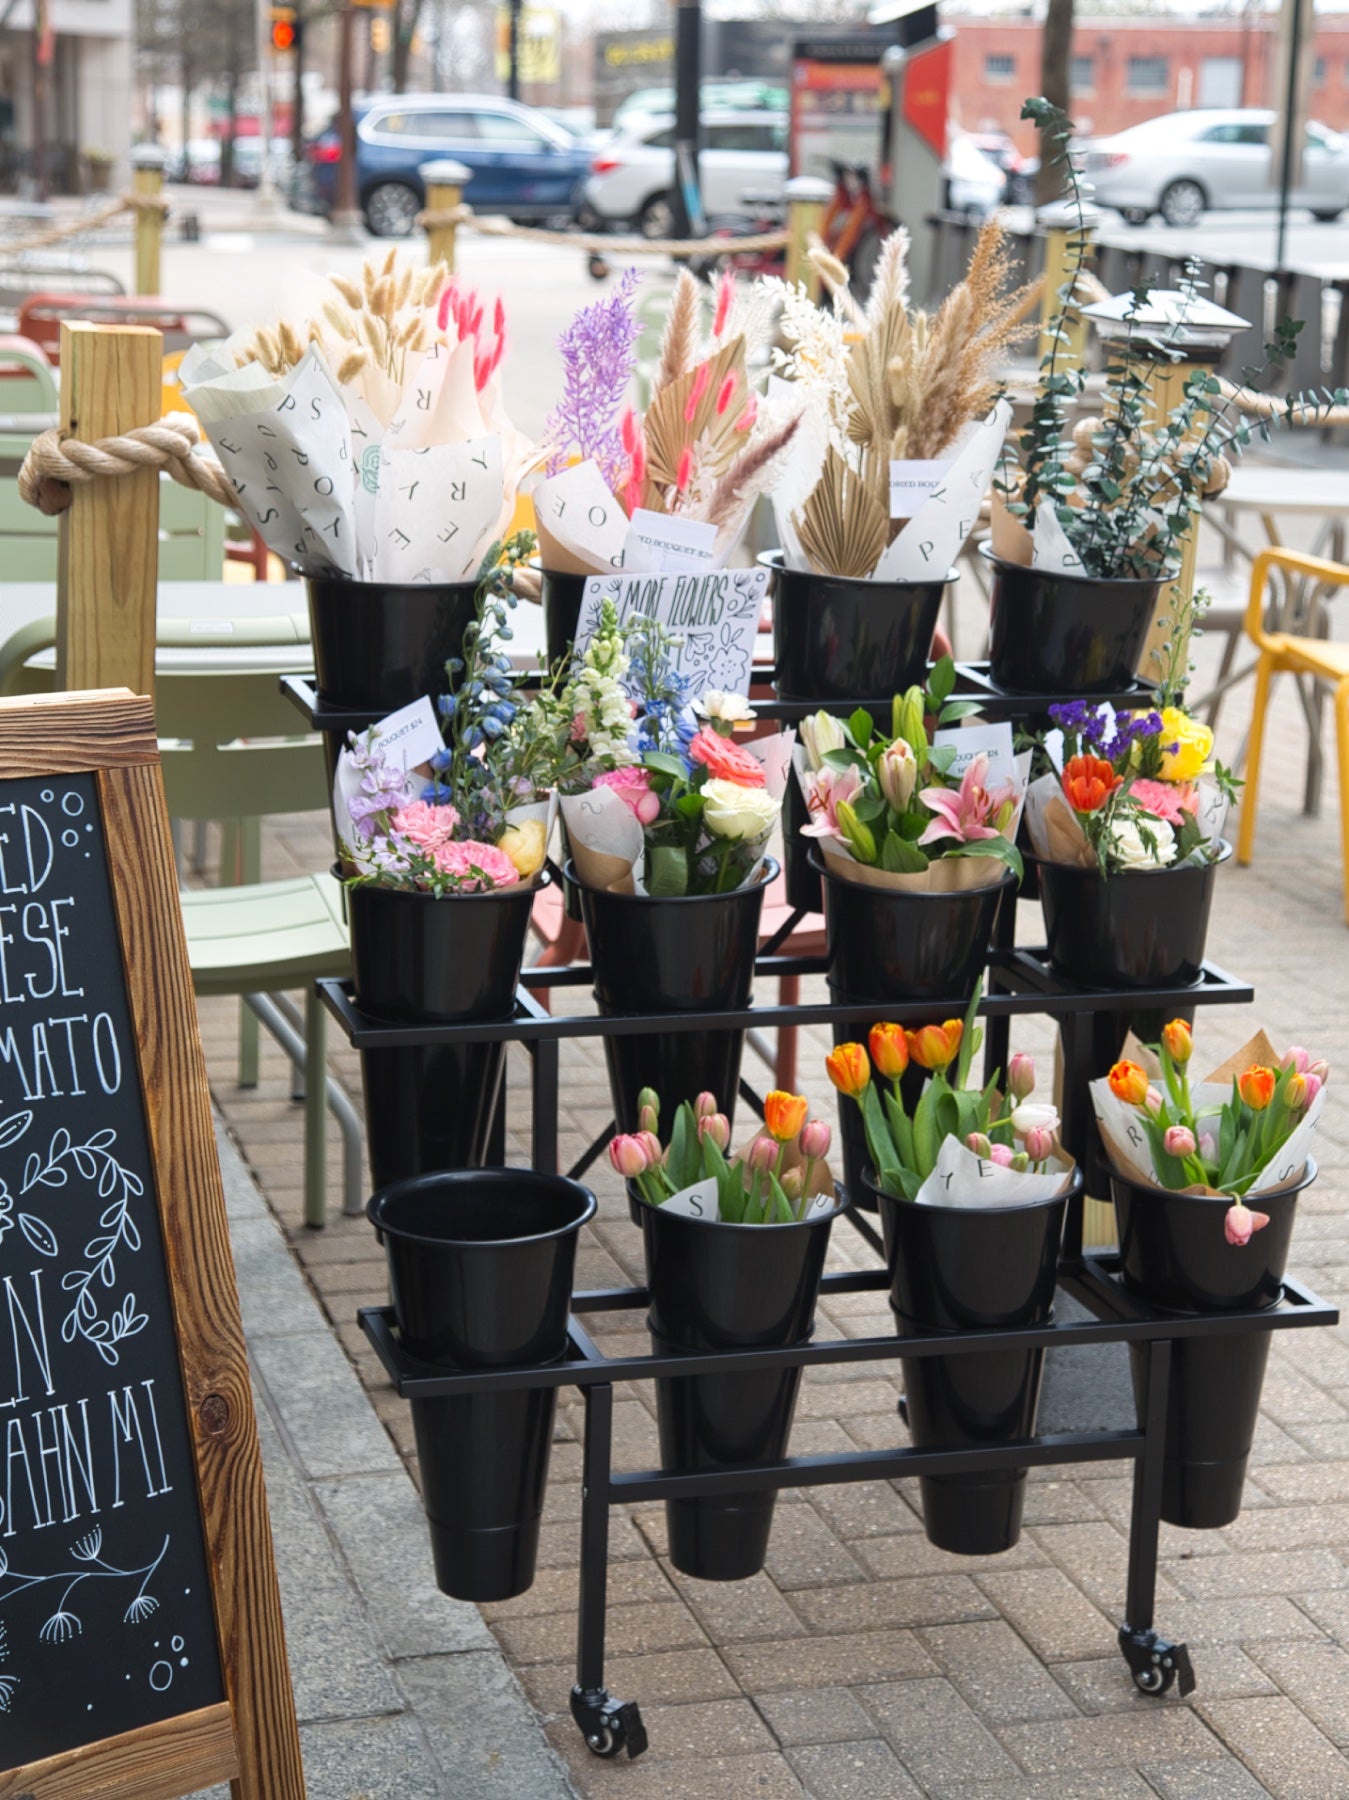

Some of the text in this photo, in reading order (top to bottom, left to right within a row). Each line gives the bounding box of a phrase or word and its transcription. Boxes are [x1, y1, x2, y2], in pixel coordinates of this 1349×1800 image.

[618, 574, 729, 627] MORE FLOWERS
[0, 1012, 122, 1101] MATO
[689, 1194, 703, 1217] S
[0, 1269, 56, 1408] N
[0, 1379, 173, 1537] AHN MI
